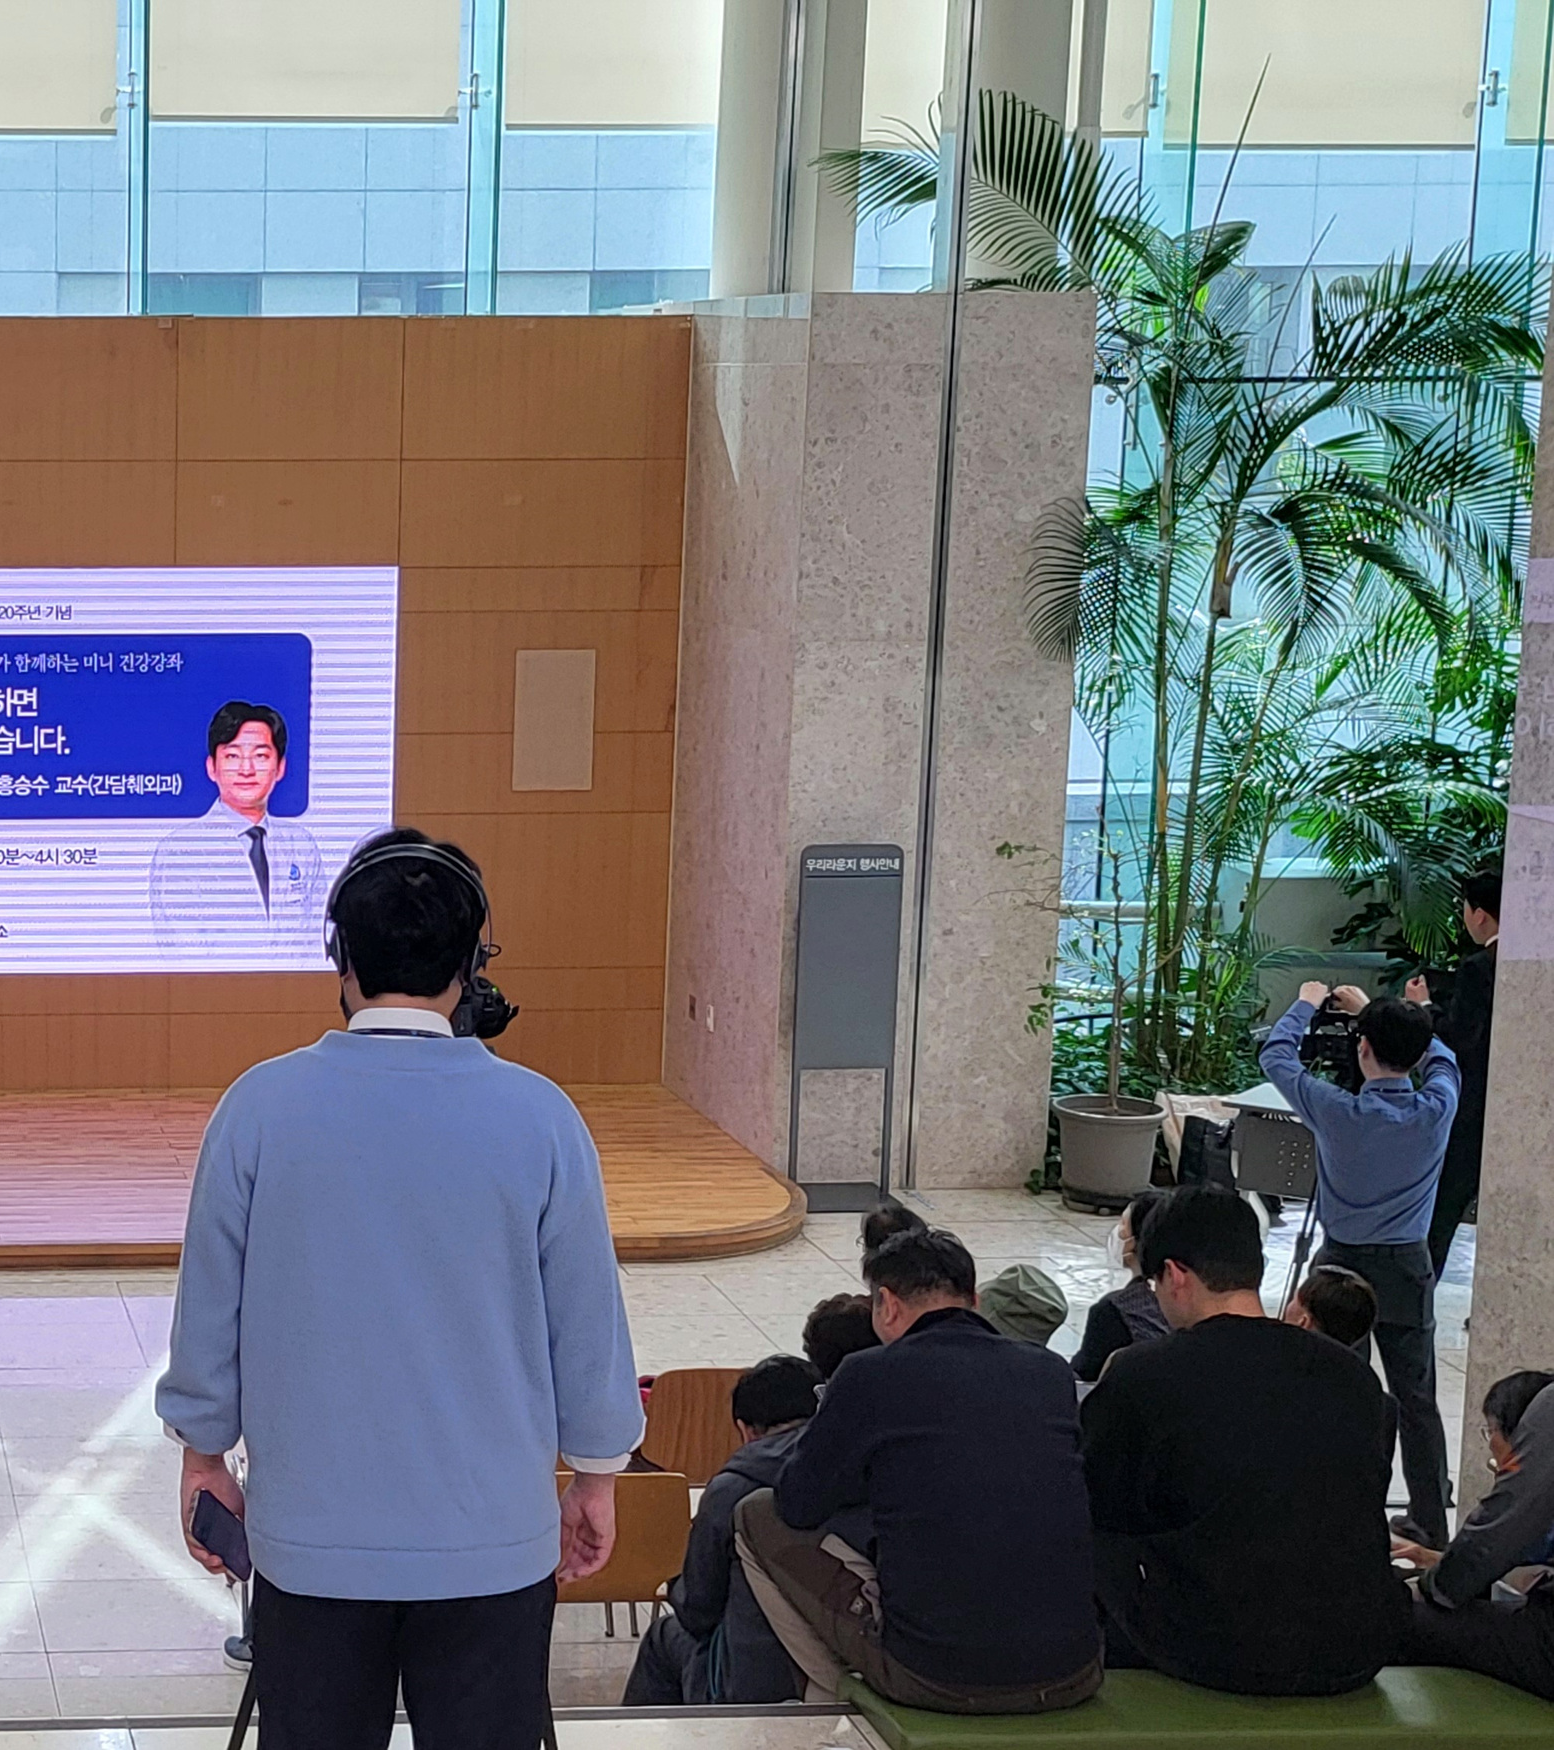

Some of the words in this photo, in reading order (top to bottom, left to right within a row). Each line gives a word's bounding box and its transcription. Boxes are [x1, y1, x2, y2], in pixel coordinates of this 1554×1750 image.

[46, 604, 72, 620] 기념
[14, 653, 79, 673] 함께하는
[83, 652, 113, 673] 미니
[54, 773, 182, 796] 교수(간담췌외과)
[63, 848, 98, 865] 30분
[806, 859, 857, 871] 우리라운지
[859, 858, 900, 871] 행사안내
